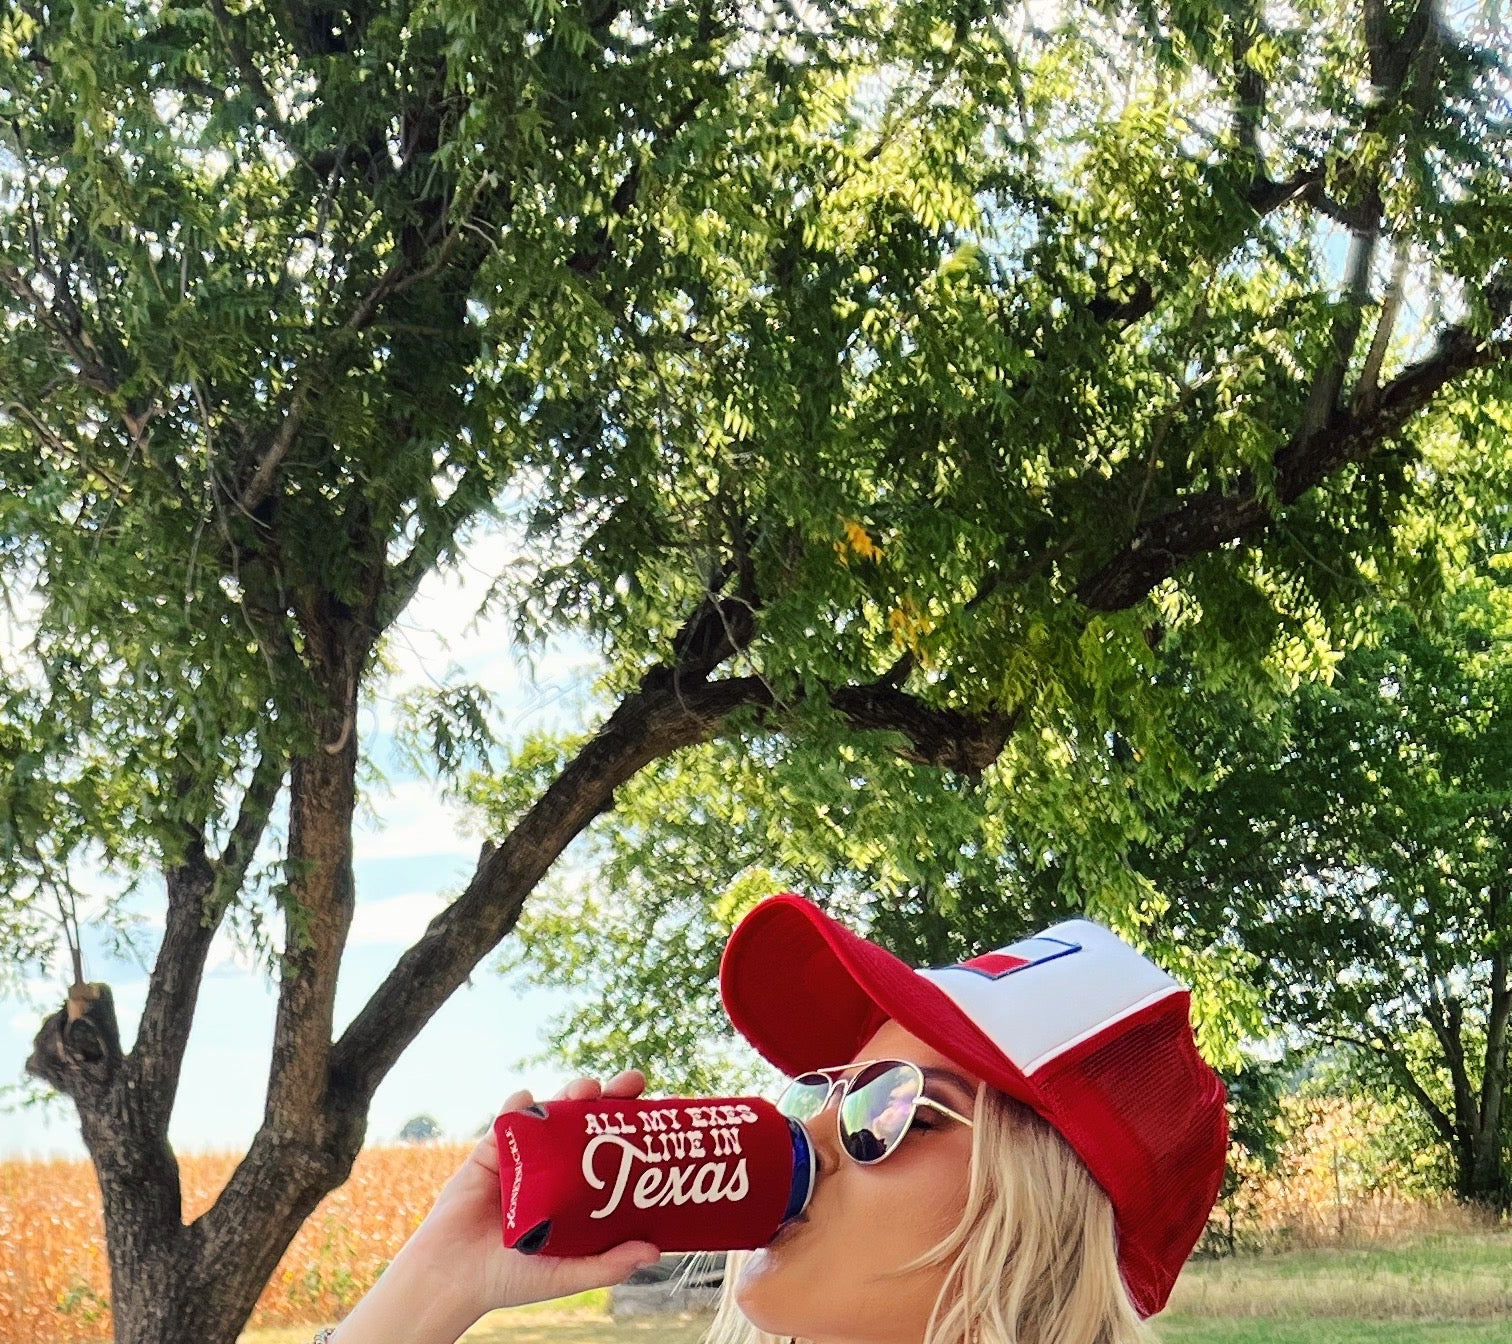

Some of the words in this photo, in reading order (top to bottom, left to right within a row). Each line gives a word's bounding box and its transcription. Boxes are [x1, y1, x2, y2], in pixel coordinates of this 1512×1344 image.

[585, 1112, 637, 1135] ALL
[637, 1108, 682, 1132] MY
[684, 1104, 759, 1127] EXES
[642, 1130, 706, 1163] LIVE
[710, 1126, 743, 1157] IN
[581, 1133, 750, 1219] Texas
